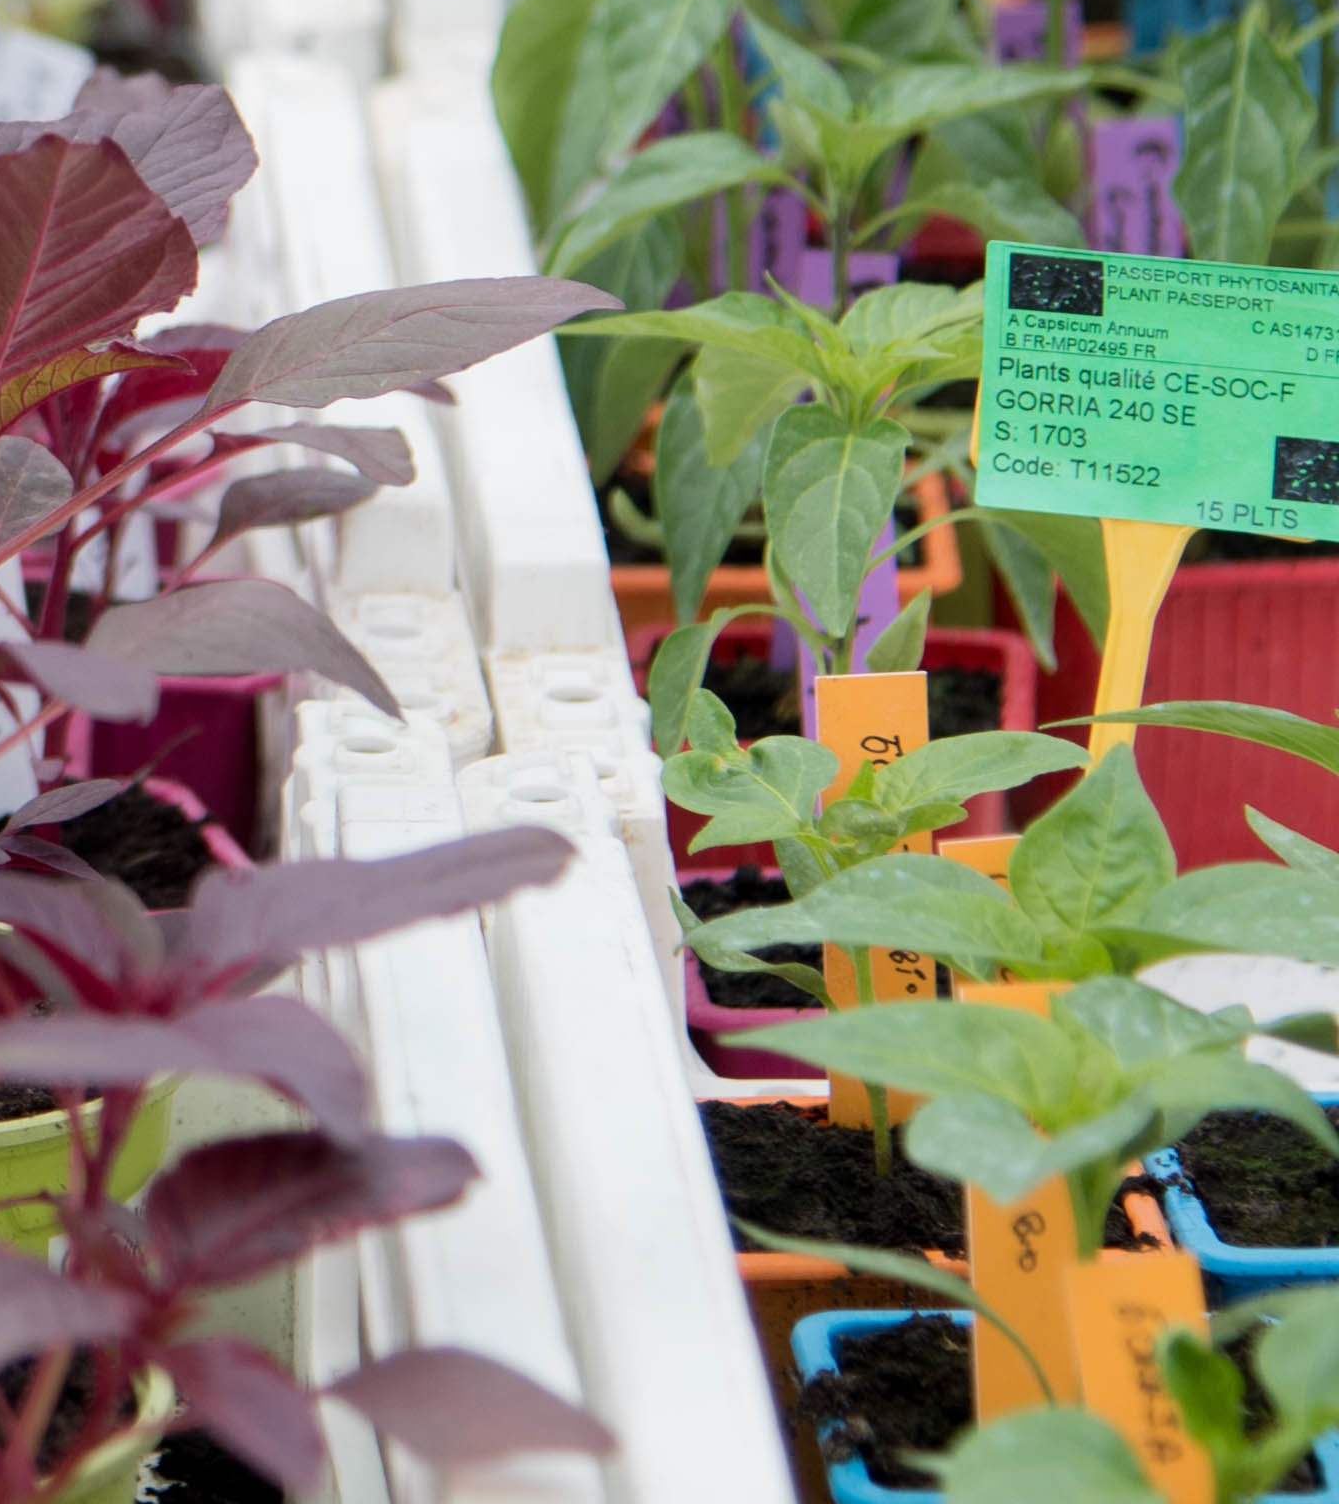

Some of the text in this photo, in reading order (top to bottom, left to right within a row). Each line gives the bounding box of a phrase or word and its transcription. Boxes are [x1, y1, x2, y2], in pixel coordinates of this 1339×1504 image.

[1107, 265, 1212, 290] PASSEPORT
[1107, 286, 1274, 312] PLANT PASSEPORT
[1008, 314, 1169, 340] A Capsicum Annuum
[1252, 320, 1265, 334] C
[1005, 333, 1017, 346] B
[1133, 344, 1157, 359] FR
[1306, 347, 1319, 362] D
[999, 357, 1296, 402] Plants qualité CE-SOC-F
[996, 389, 1196, 426] GORRIA 240 SE
[995, 420, 1087, 448] S: 1703
[993, 452, 1161, 487] Code: T11522
[1196, 500, 1299, 529] 15 PLTS
